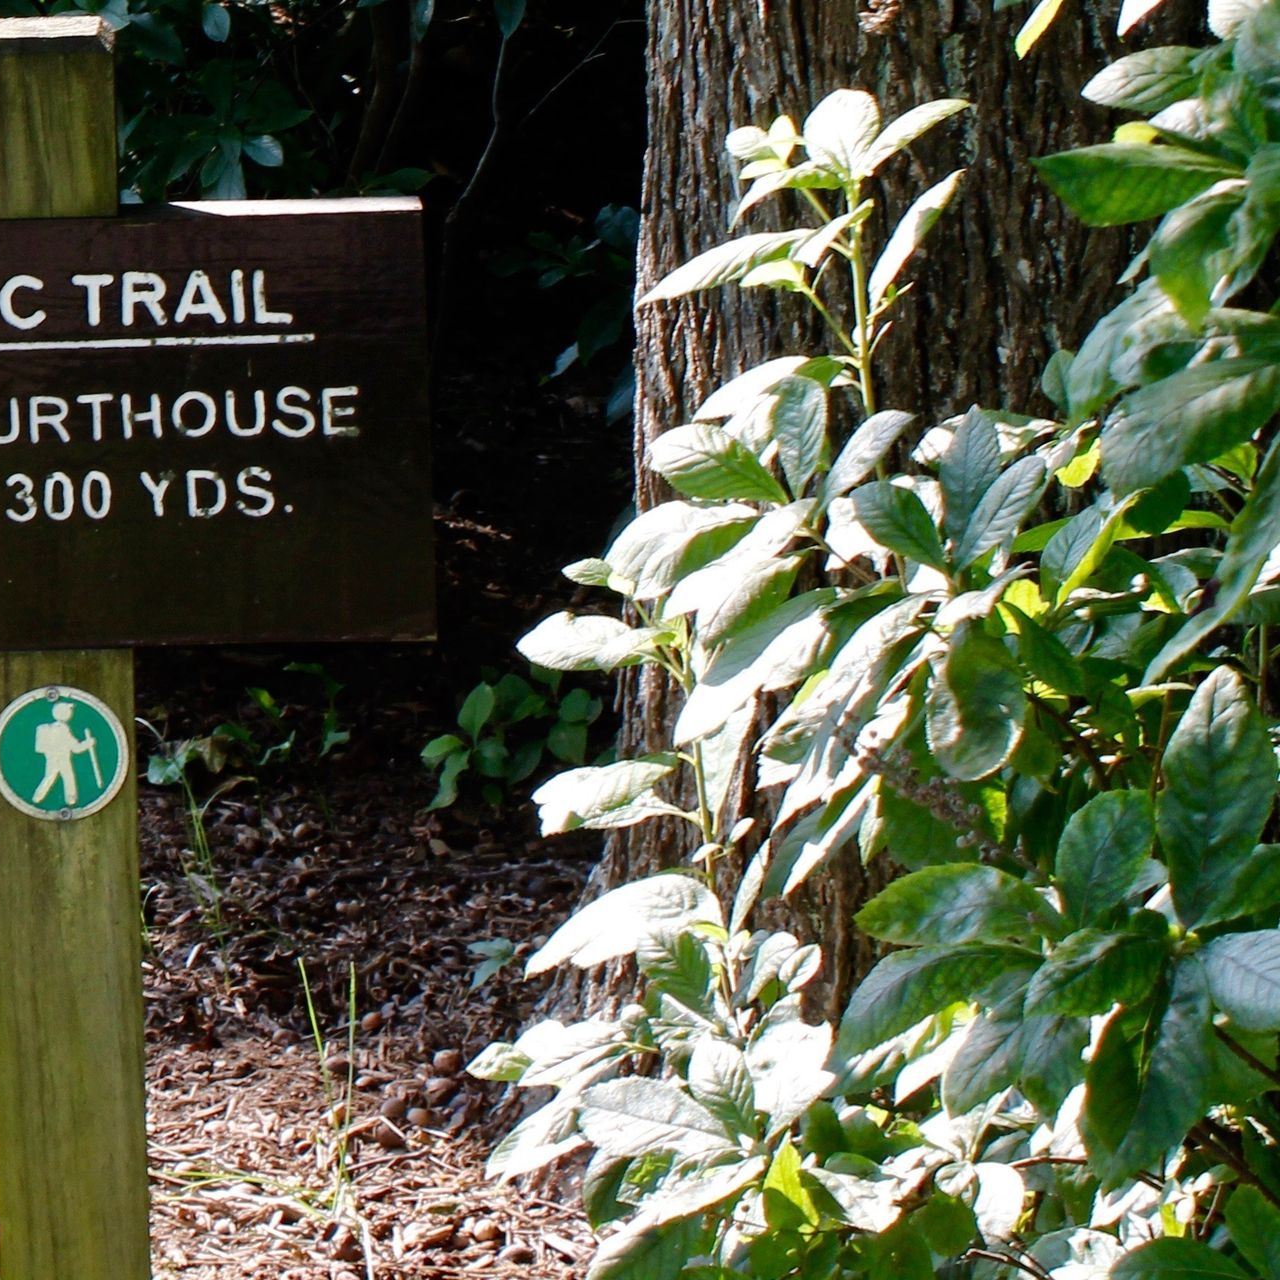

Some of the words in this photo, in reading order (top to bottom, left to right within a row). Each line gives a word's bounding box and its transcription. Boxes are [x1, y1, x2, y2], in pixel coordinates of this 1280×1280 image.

[71, 269, 294, 327] TRAIL
[6, 470, 112, 522] 300
[140, 466, 295, 518] YDS.
